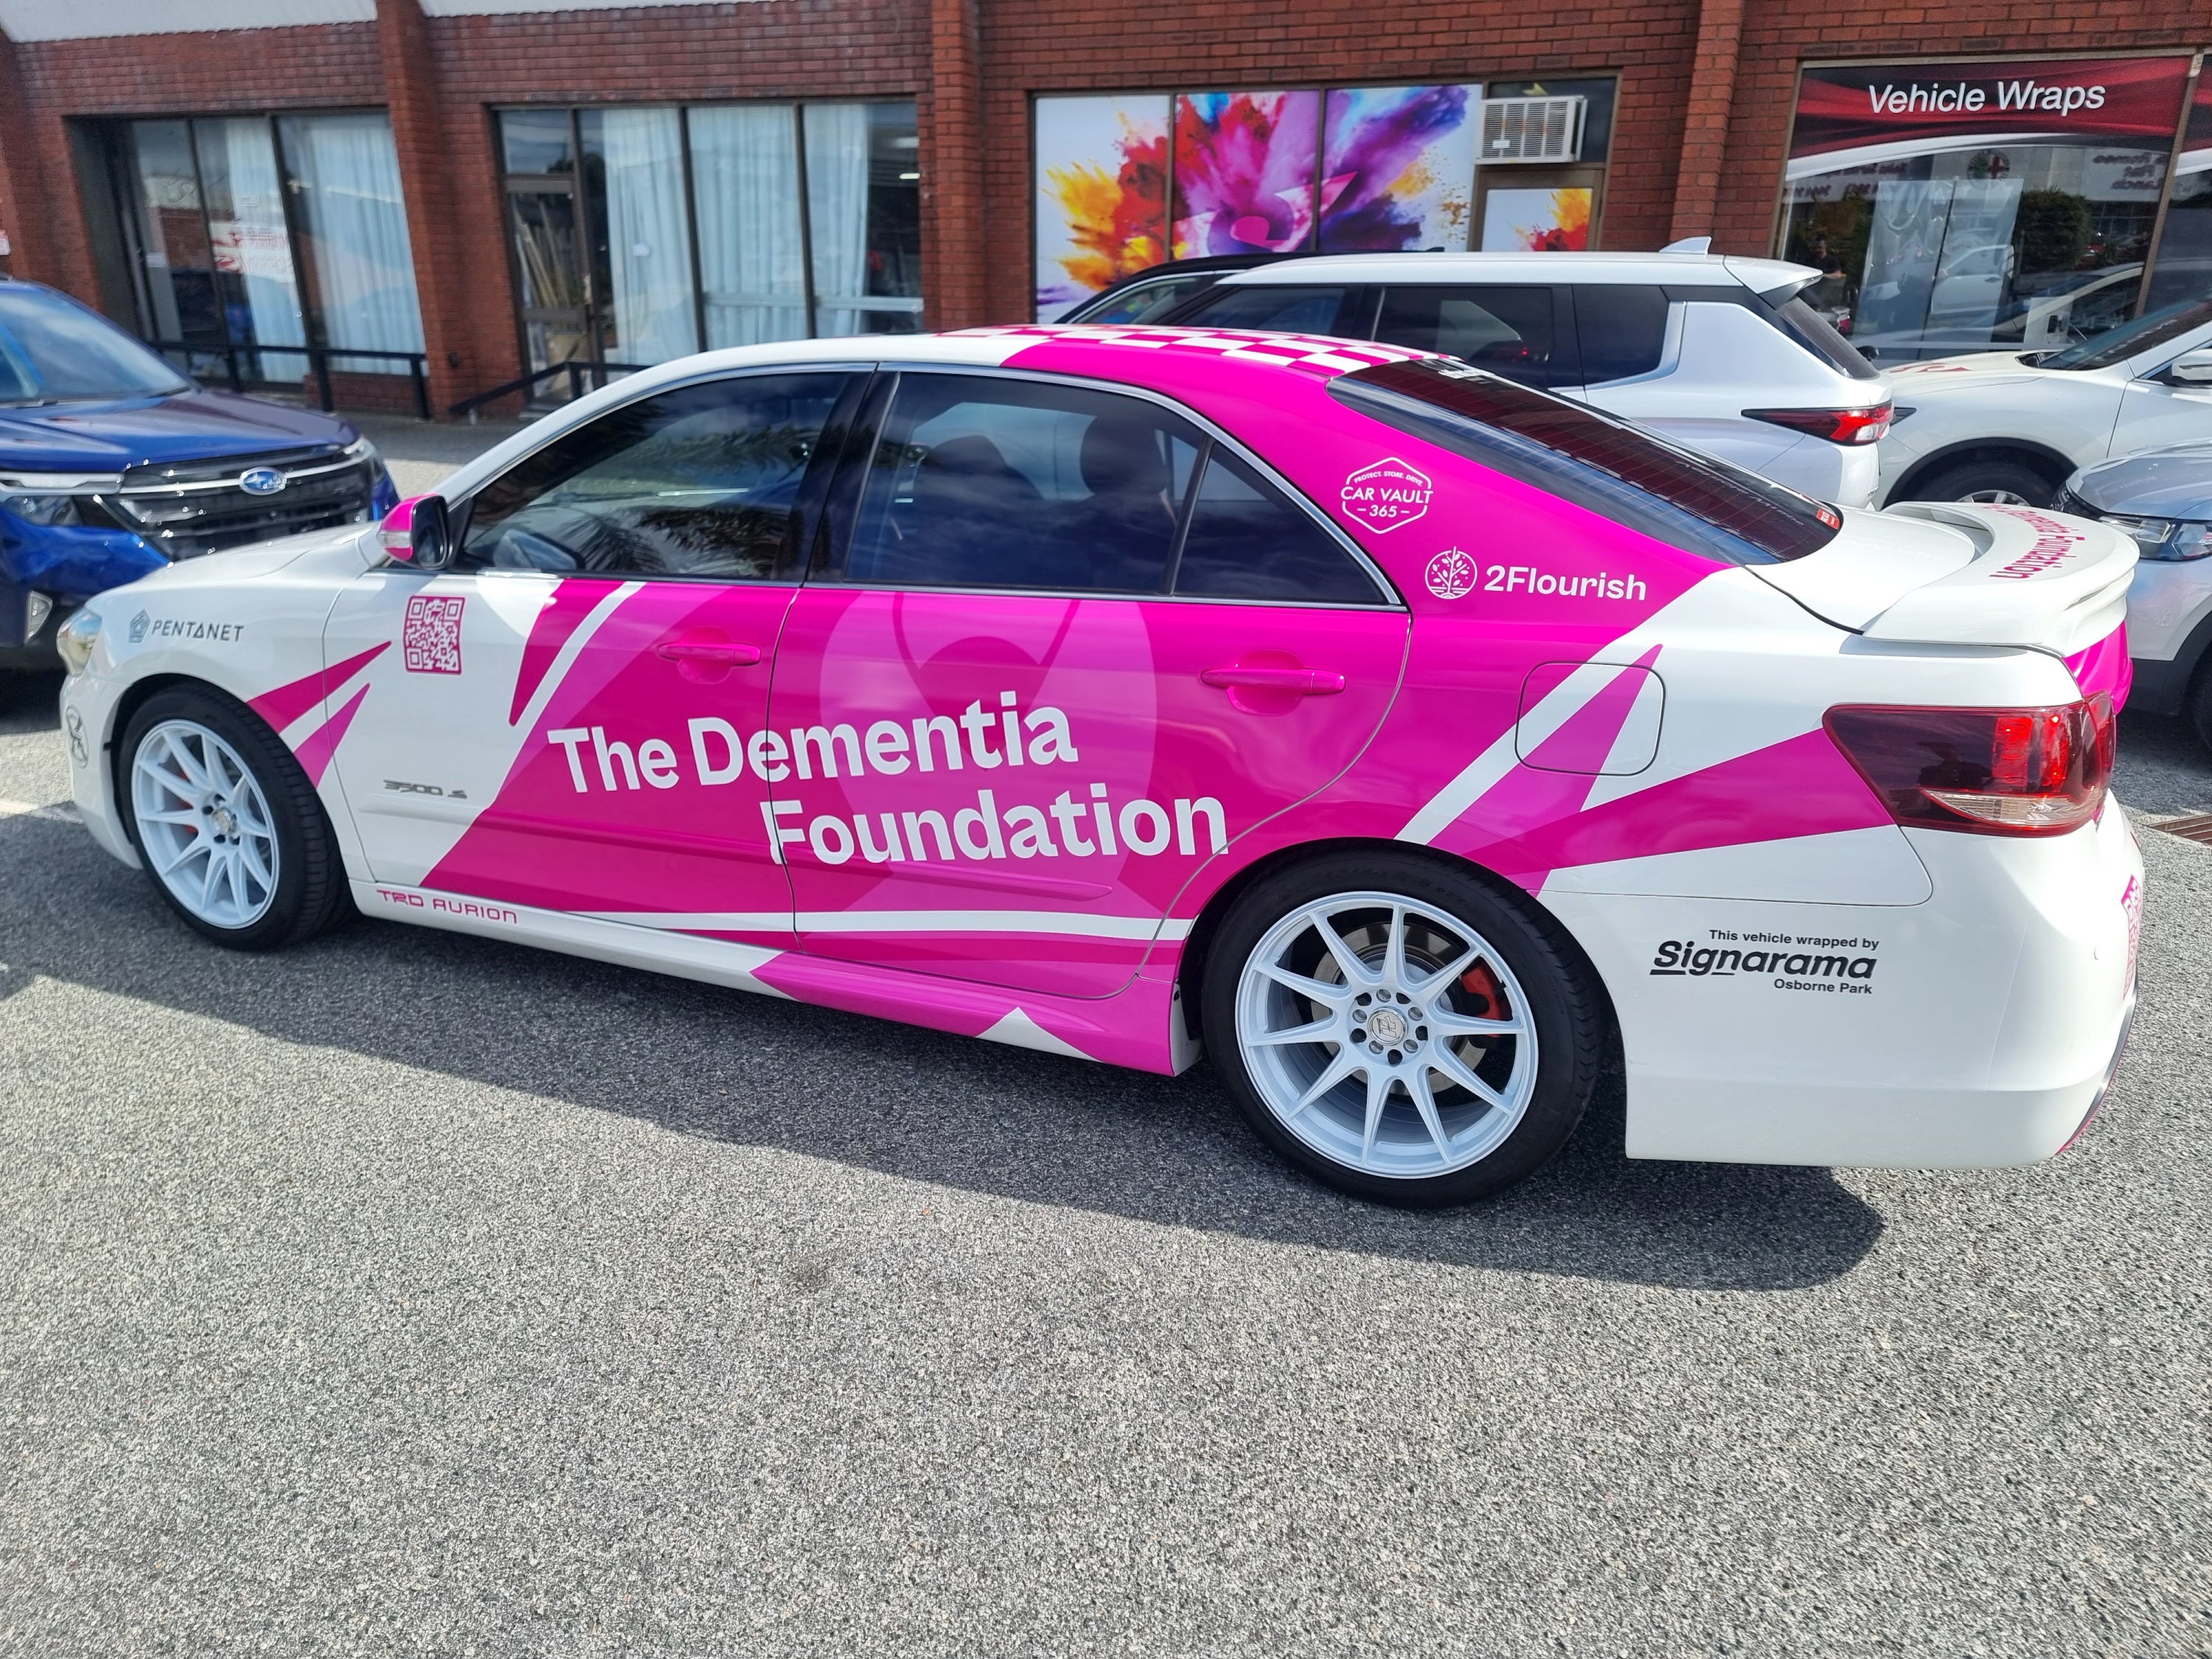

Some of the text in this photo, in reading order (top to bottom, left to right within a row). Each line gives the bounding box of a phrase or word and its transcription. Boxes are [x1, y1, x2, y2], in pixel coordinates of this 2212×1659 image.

[1869, 80, 2106, 116] Vehicle Wraps
[1340, 486, 1433, 504] CAR VAULT
[1369, 504, 1397, 518] 365
[1989, 534, 2086, 579] Foundation
[1484, 565, 1646, 600] 2Flourish
[151, 619, 244, 642] PENTANET
[548, 690, 1079, 793] The Dementia
[759, 782, 1229, 865] Foundation
[376, 889, 517, 925] TRD AURION
[1709, 930, 1879, 950] This vehicle wrapped by
[1652, 940, 1877, 979] Signarama
[1774, 978, 1873, 994] Osborne Park
